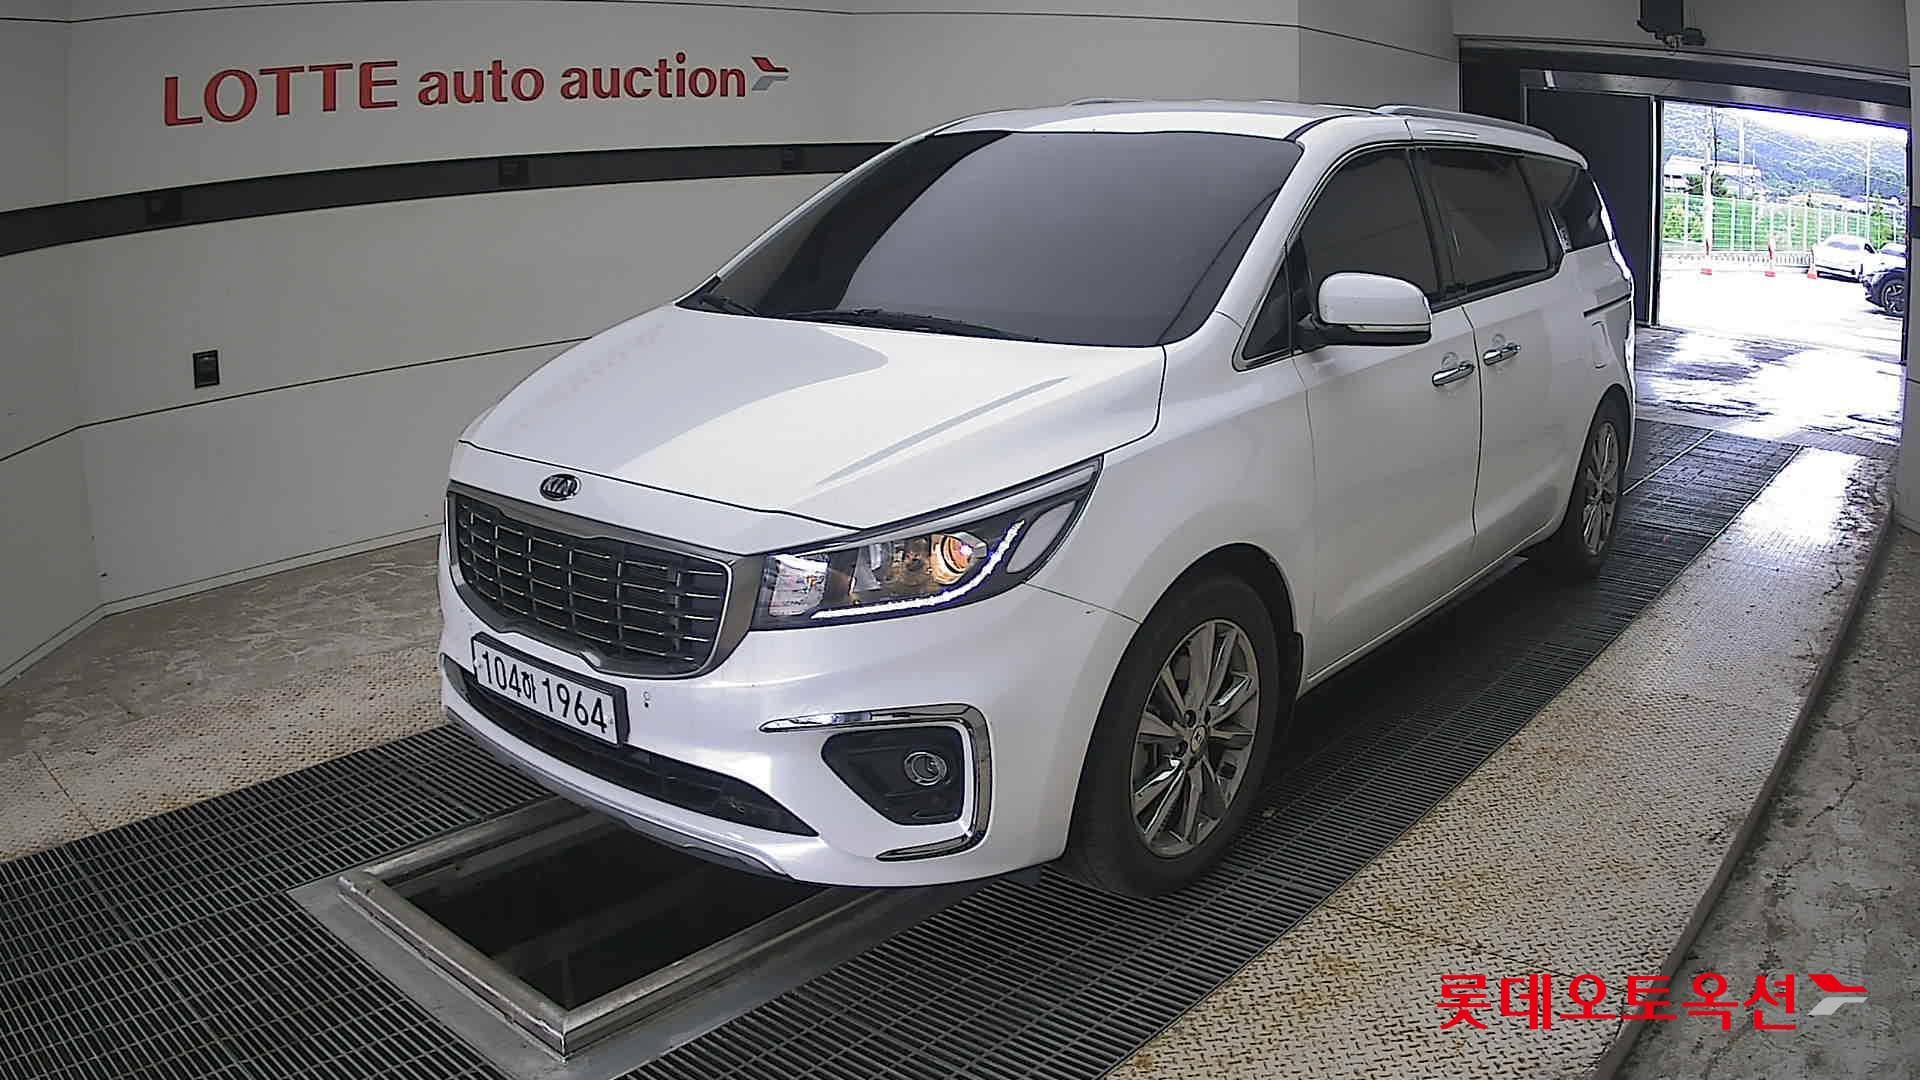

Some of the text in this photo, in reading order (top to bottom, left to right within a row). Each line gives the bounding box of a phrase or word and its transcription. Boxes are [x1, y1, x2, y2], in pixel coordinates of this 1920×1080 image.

[164, 52, 747, 126] LOTTE auto auction
